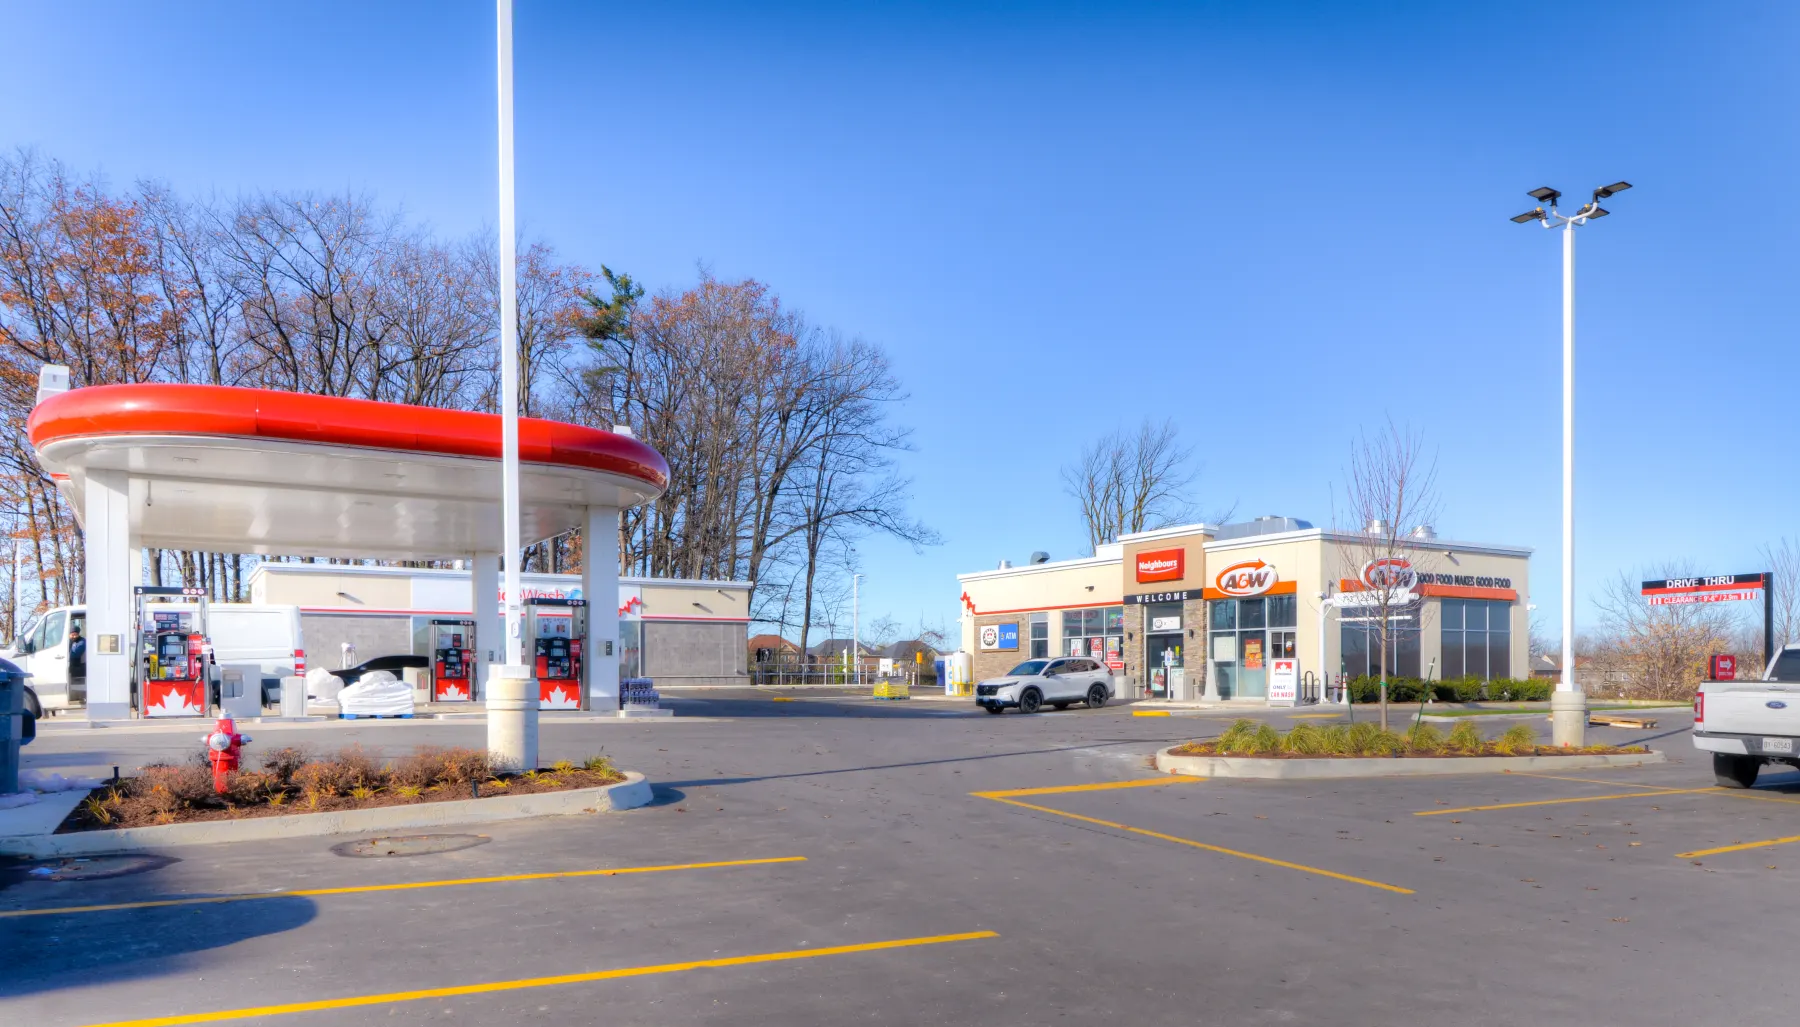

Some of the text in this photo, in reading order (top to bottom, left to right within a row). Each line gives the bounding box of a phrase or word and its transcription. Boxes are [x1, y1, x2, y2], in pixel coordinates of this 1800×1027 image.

[1138, 559, 1178, 571] Neighbours
[1224, 570, 1270, 591] A&W
[1416, 572, 1511, 588] GOOD FOOD MAKES GOOD FOOD
[1666, 576, 1735, 589] DRIVE THRU
[1136, 591, 1188, 604] WELCOME
[1664, 595, 1702, 604] CLEARANCE
[1005, 632, 1017, 640] ATM
